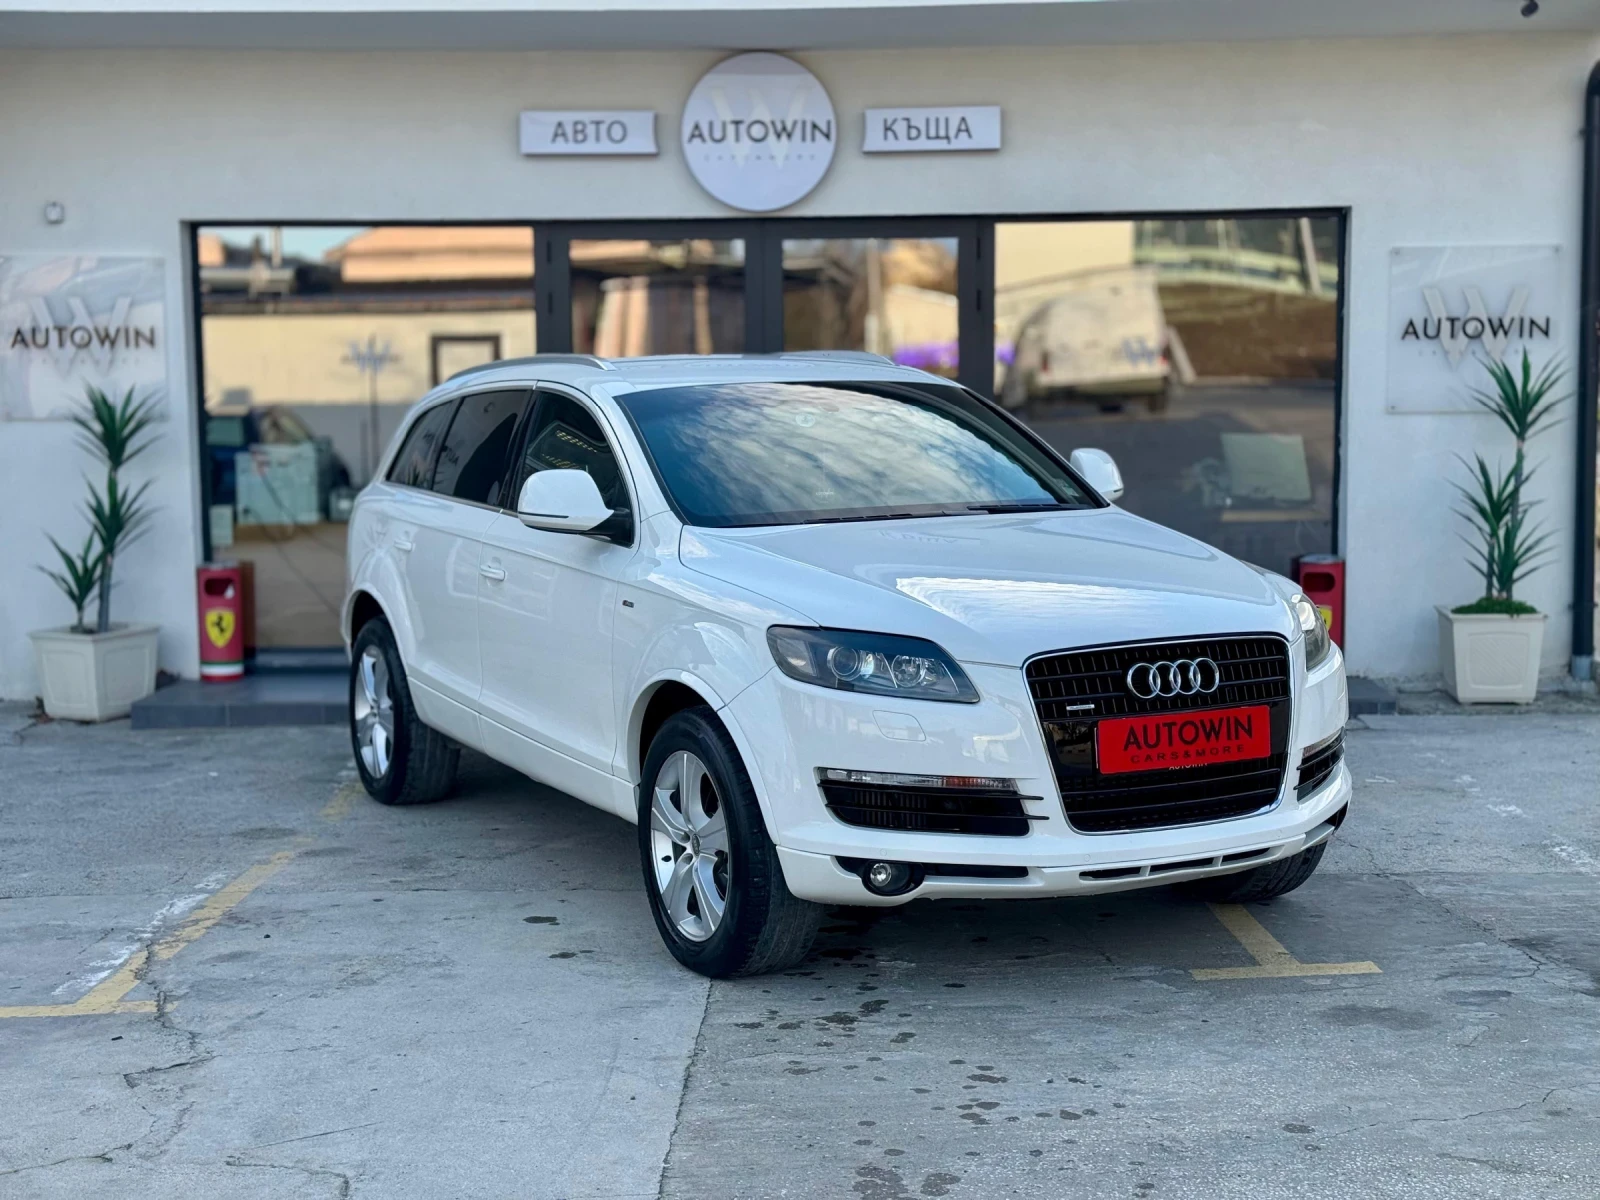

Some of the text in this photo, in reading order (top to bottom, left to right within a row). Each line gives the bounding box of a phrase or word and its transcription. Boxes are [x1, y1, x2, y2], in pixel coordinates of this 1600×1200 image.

[550, 119, 628, 144] АВТО
[687, 119, 832, 143] AUTOWIN
[883, 116, 973, 145] КЪЩА
[11, 325, 156, 349] AUTOWIN
[1401, 315, 1551, 340] AUTOWIN
[1123, 714, 1253, 752] AUTOWIN
[1130, 744, 1245, 765] CARS&MORE
